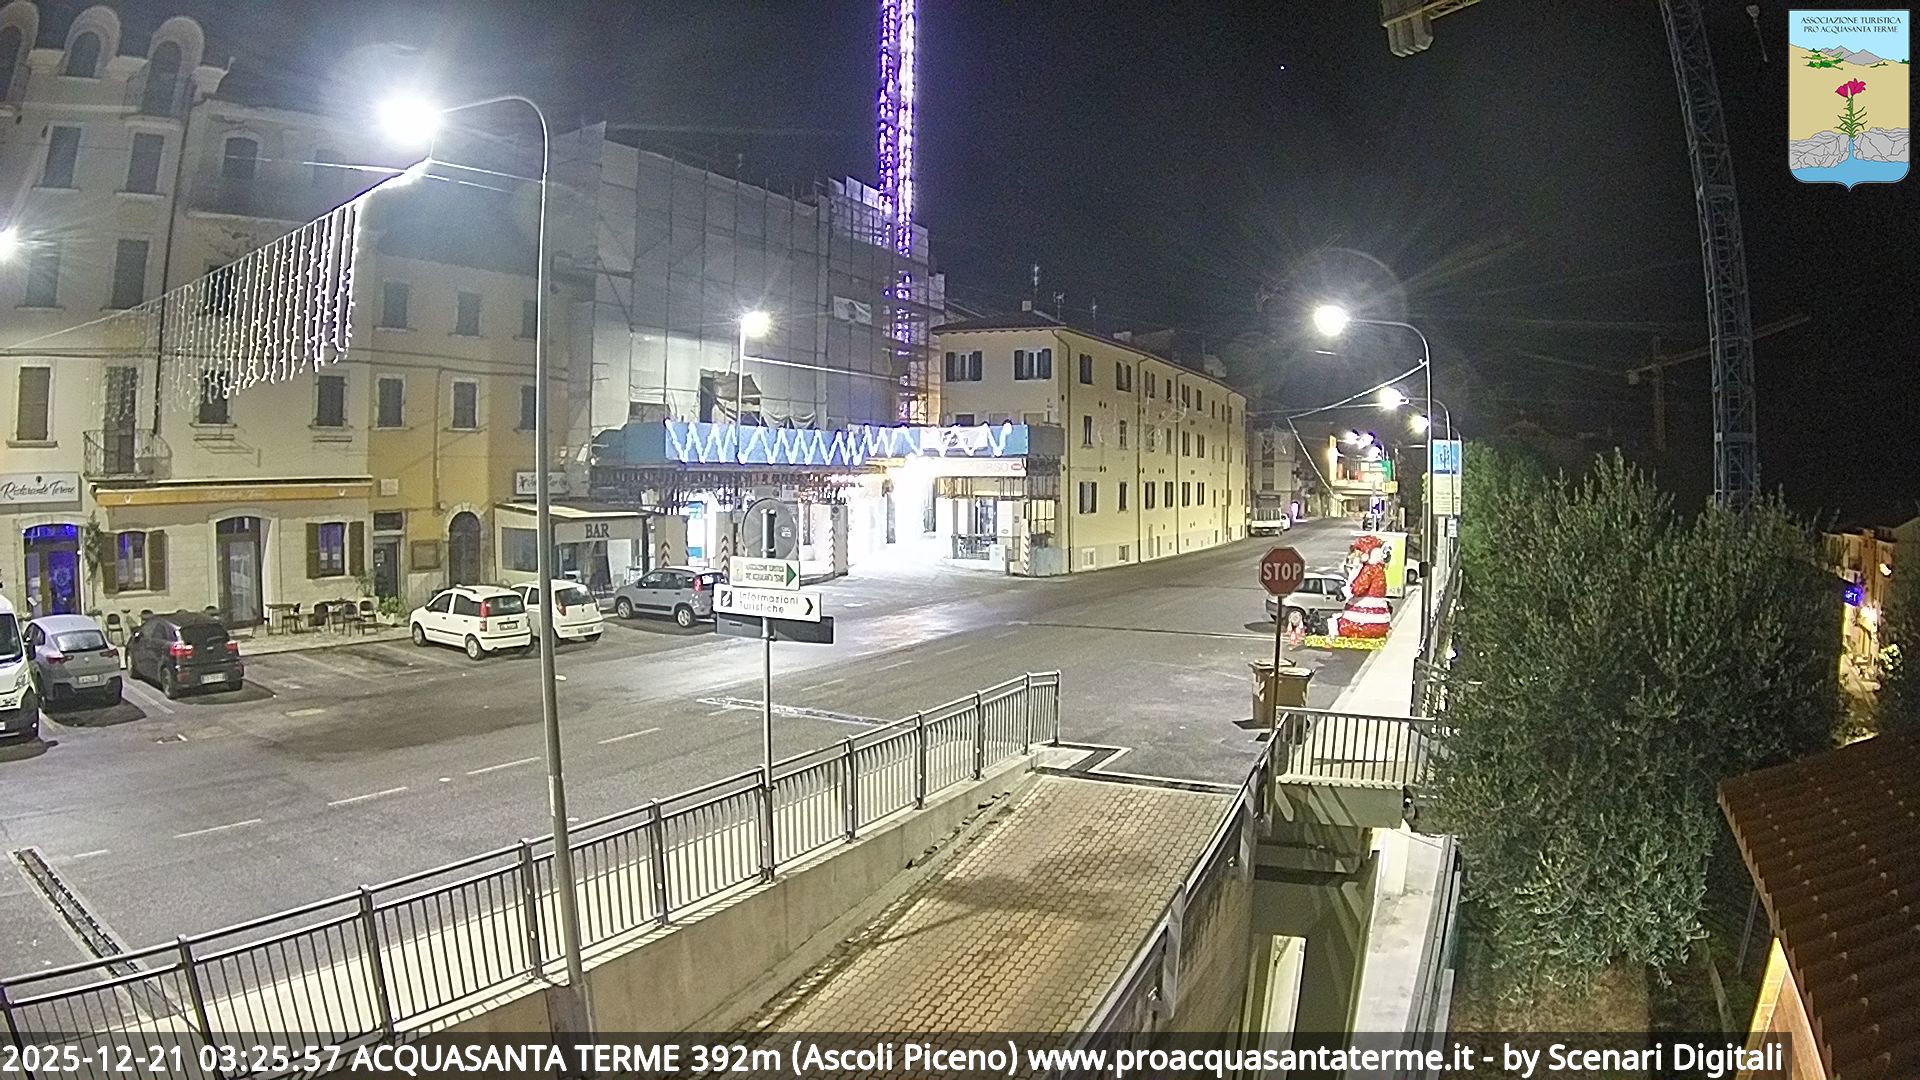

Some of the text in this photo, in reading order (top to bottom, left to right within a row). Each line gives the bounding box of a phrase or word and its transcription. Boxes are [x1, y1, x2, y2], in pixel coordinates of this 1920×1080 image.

[585, 523, 610, 539] BAR
[1263, 563, 1301, 581] STOP
[739, 591, 799, 605] Informazioni
[739, 601, 785, 614] Turistiche
